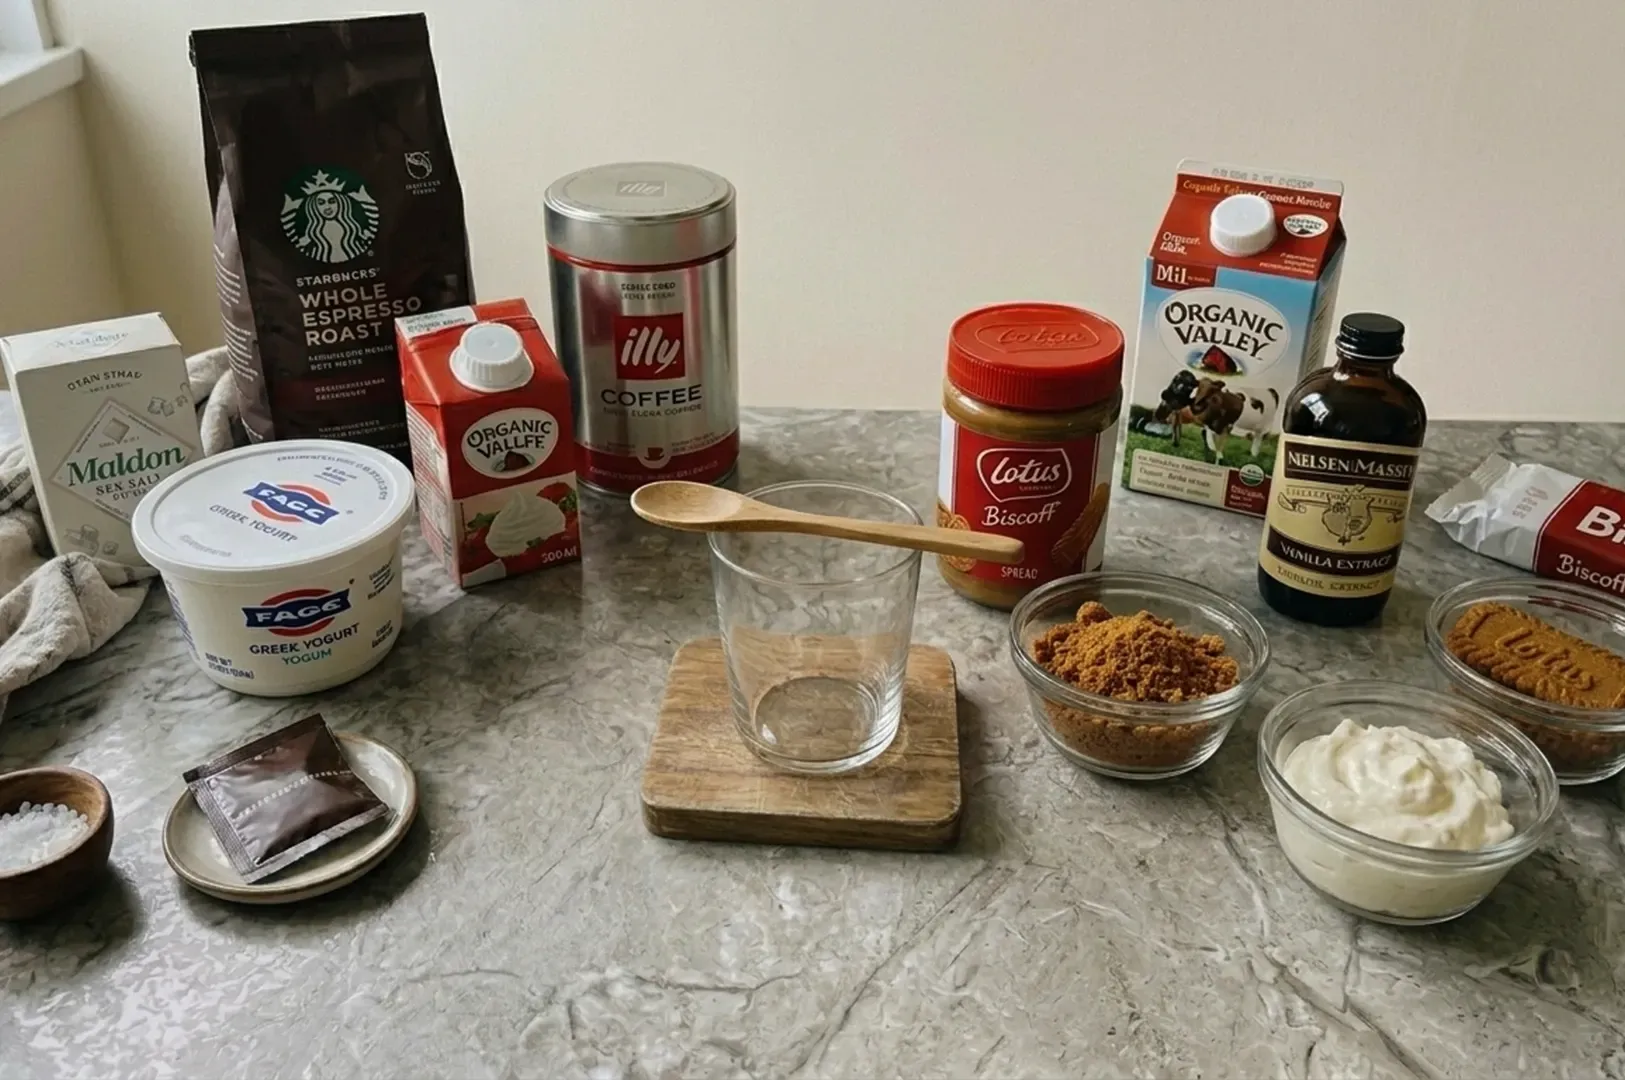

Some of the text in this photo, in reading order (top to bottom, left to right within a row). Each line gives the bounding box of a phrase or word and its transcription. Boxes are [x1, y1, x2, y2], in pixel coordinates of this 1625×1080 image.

[299, 283, 388, 309] WHOLE
[302, 296, 421, 328] ESPRESSO
[1165, 301, 1284, 342] ORGANIC
[305, 322, 382, 347] ROAST
[1174, 324, 1270, 358] VALLEY
[621, 326, 681, 374] illy
[601, 384, 702, 408] COFFEE
[467, 420, 552, 448] ORGANIC
[67, 447, 186, 487] Maldon
[990, 457, 1061, 484] Lotus
[981, 502, 1058, 526] Biscoff
[249, 641, 299, 655] GREEK
[302, 622, 360, 650] YOGURT
[281, 647, 332, 666] YOGUM
